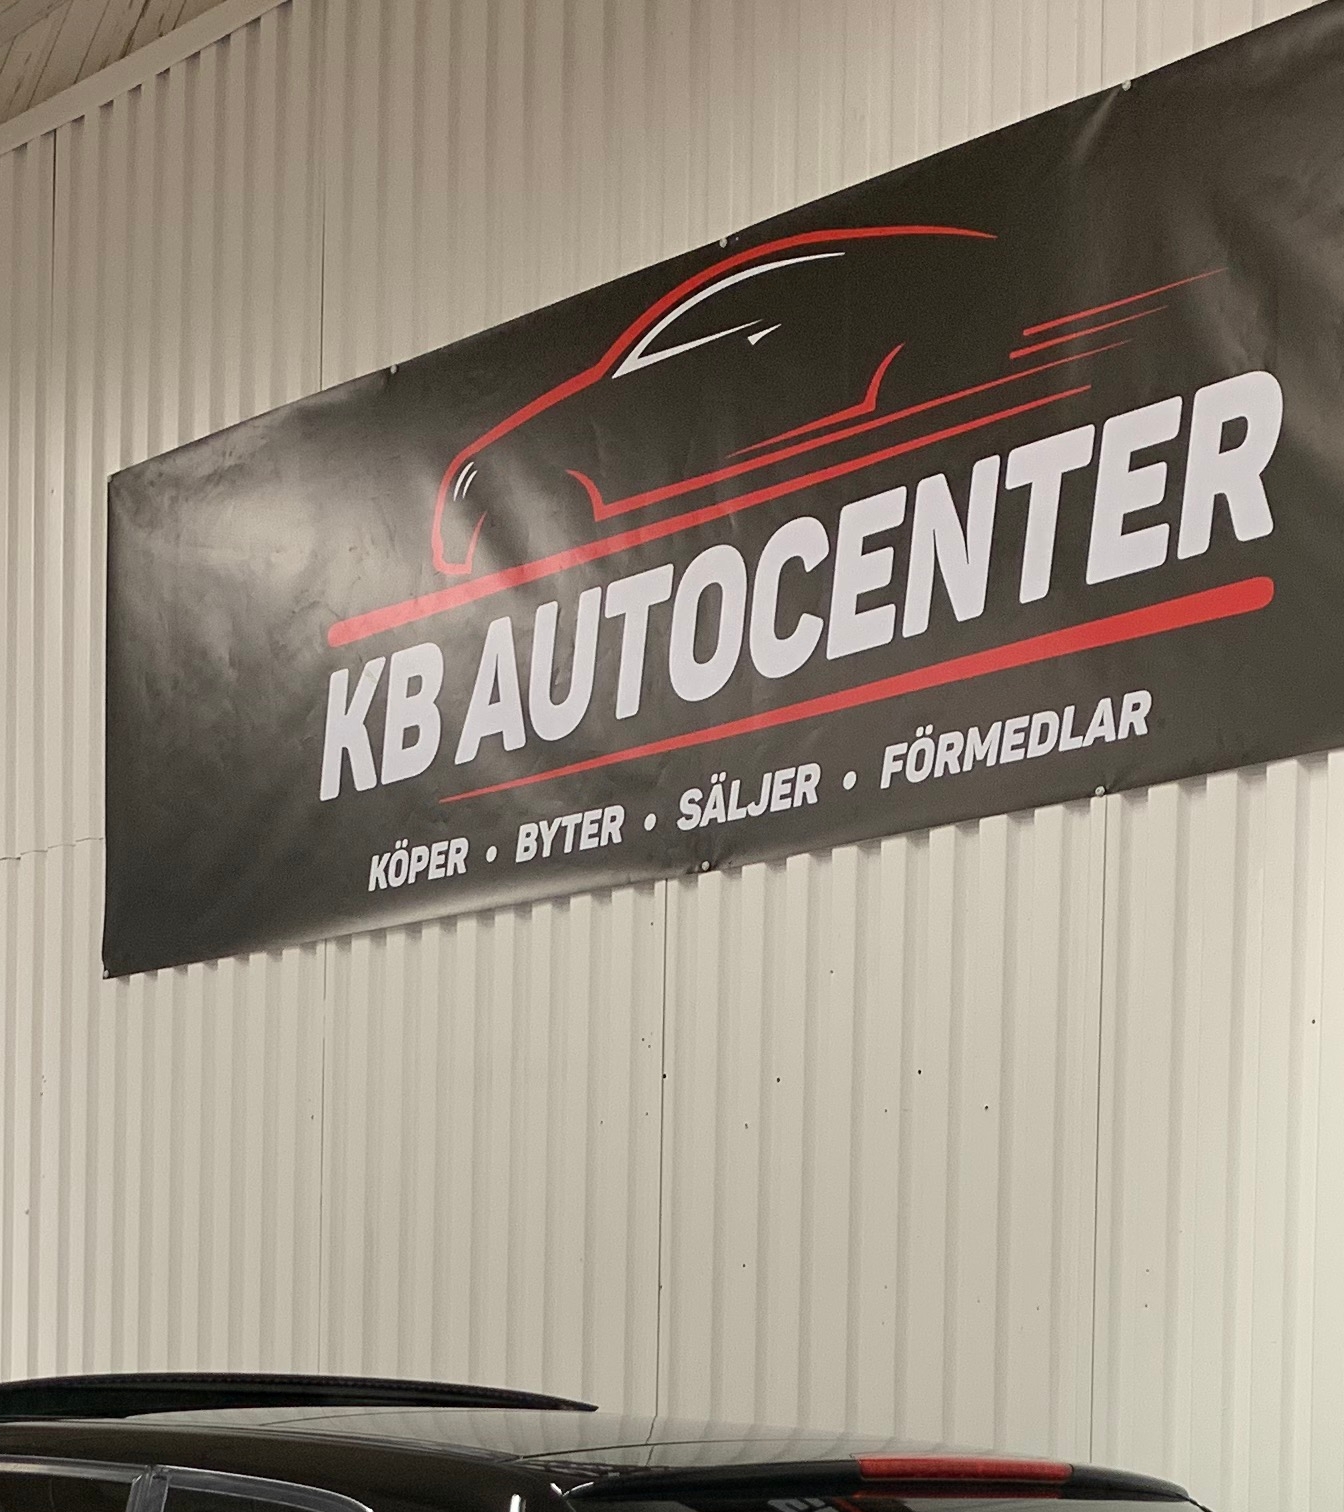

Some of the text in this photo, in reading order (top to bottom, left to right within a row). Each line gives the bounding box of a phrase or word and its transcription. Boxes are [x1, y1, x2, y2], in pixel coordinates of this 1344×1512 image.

[320, 369, 1284, 802] KB AUTOCENTER
[368, 689, 1153, 892] KÖPER BYTER SÄLJER FÖRMEDLAR
